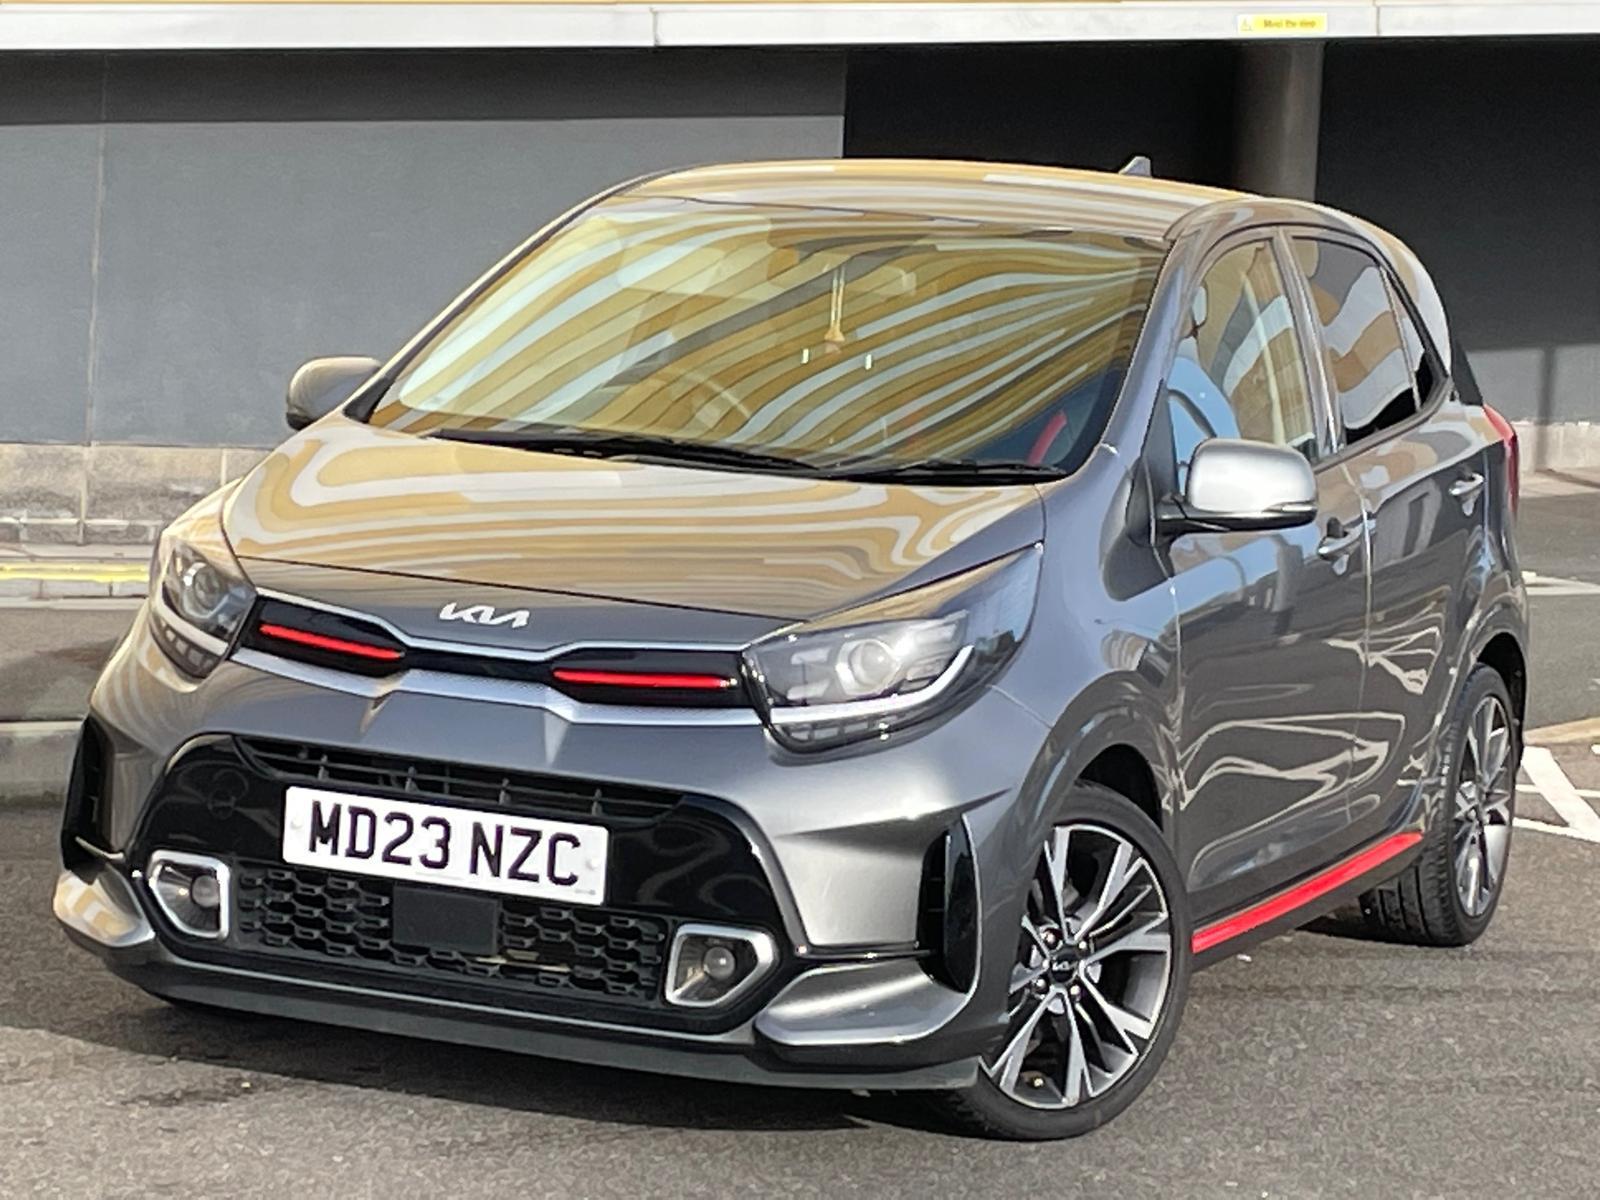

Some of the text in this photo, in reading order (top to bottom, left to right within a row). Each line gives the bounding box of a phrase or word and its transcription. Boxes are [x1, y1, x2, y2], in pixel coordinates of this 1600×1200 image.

[439, 602, 530, 629] KIA
[308, 800, 581, 887] MD23 NZC
